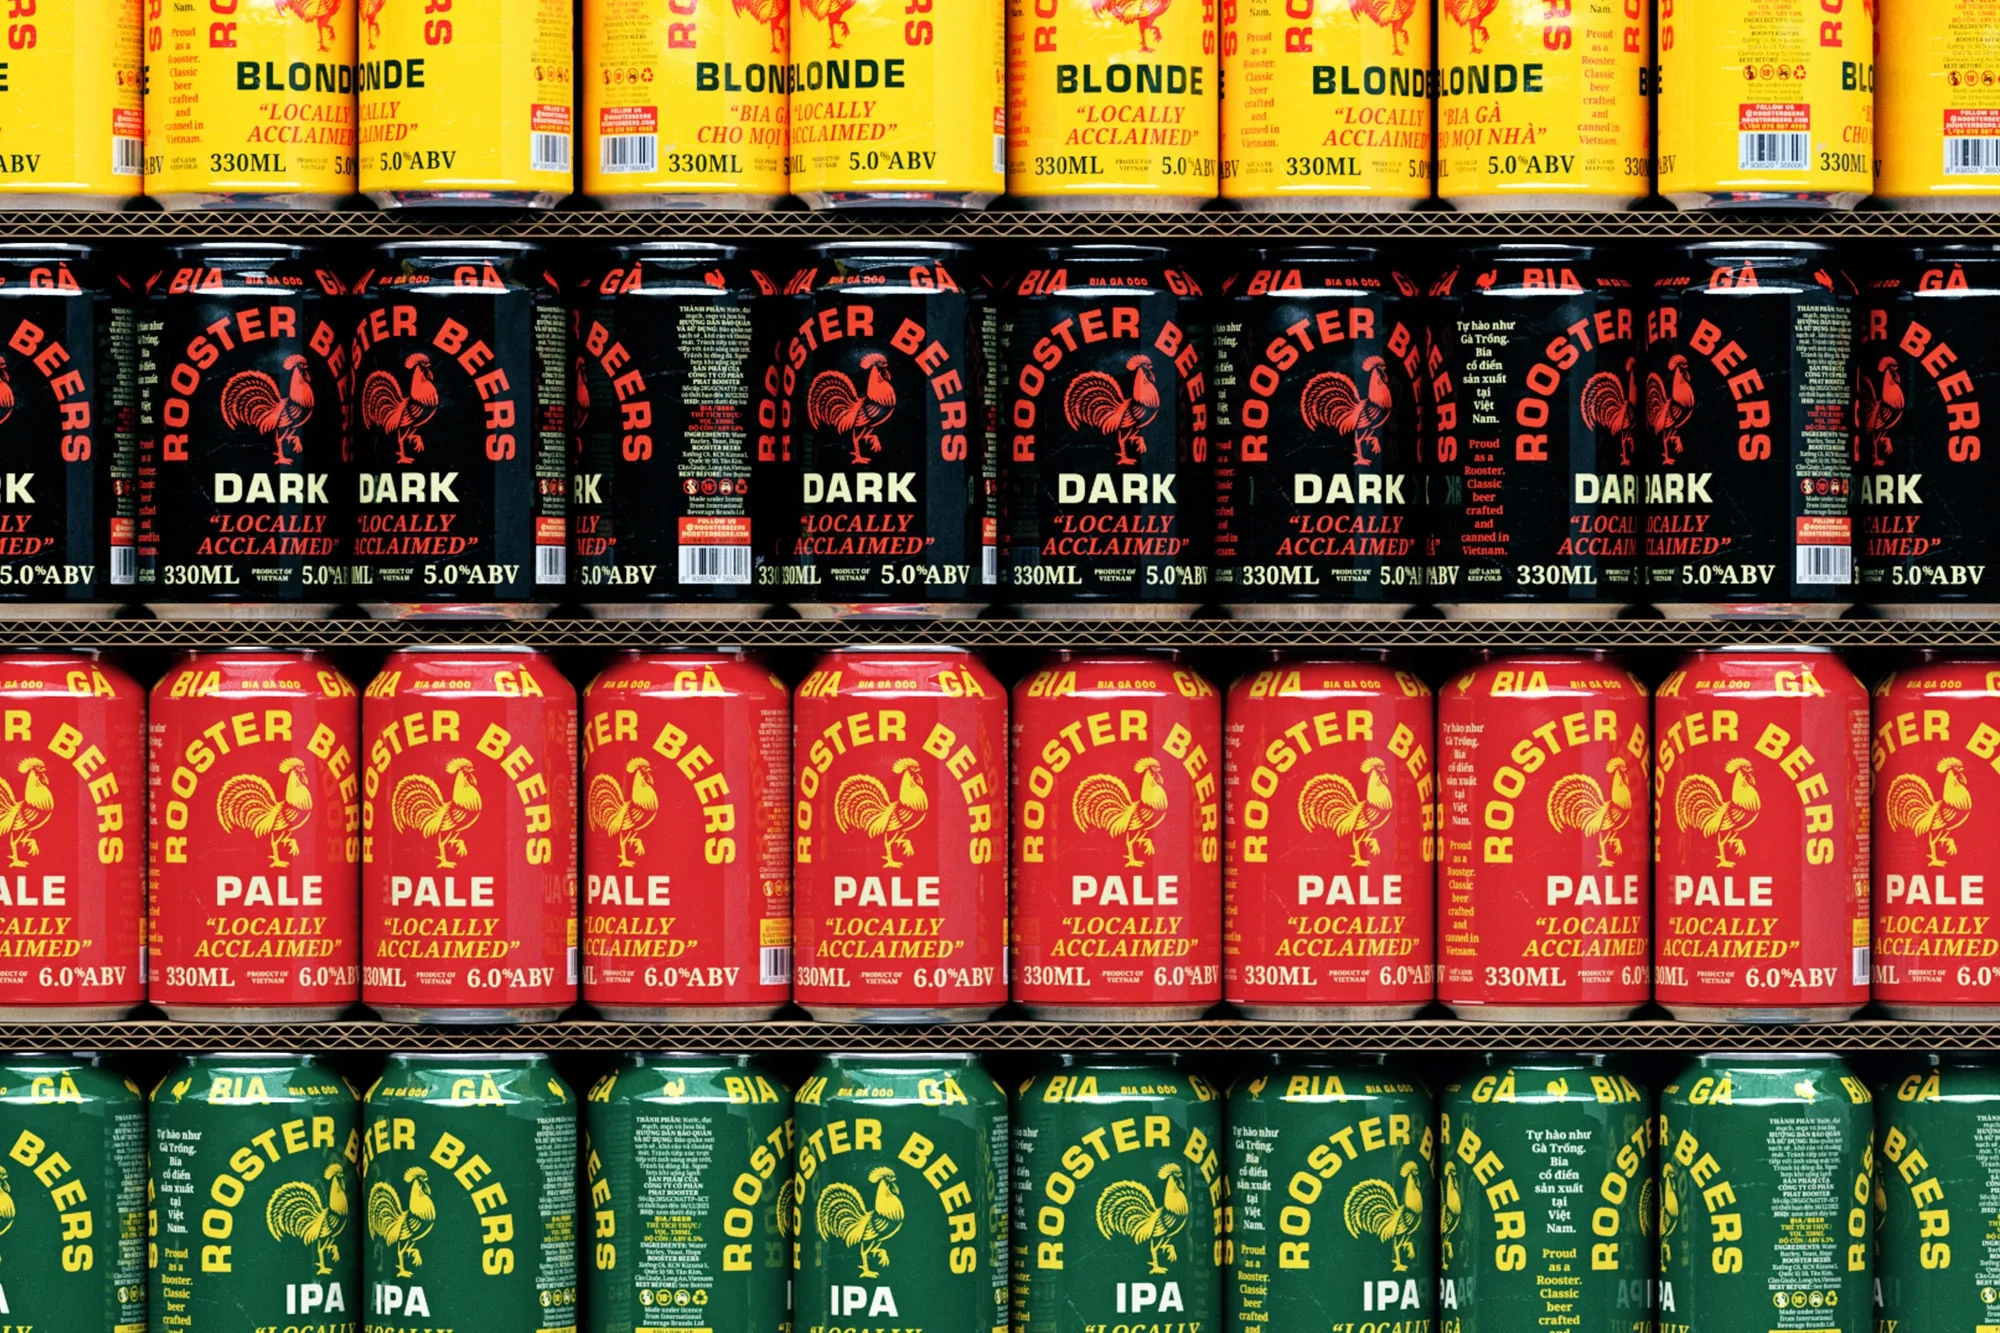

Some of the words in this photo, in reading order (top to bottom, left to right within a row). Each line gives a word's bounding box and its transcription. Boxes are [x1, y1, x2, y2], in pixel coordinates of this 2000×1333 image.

[1587, 29, 1613, 39] Proud
[1057, 64, 1203, 95] BLONDE
[1077, 105, 1186, 127] “LOCALLY
[1592, 109, 1608, 118] and
[698, 126, 743, 143] CHO
[1066, 128, 1199, 145] ACCLAIMED”
[1488, 123, 1546, 144] NHÀ”
[211, 154, 286, 172] 330ML
[381, 151, 456, 171] 5.0%ABV
[669, 154, 742, 173] 330ML
[850, 151, 936, 170] 5.0%ABV
[1035, 156, 1103, 175] 330ML
[1287, 157, 1361, 175] 330ML
[1489, 156, 1574, 174] 5.0%ABV
[1821, 152, 1867, 173] 330ML
[1472, 321, 1492, 332] hào
[1495, 320, 1515, 330] như
[1461, 334, 1473, 344] Gà
[1476, 347, 1492, 357] Bia
[9, 319, 91, 462] BEERS
[164, 306, 296, 461] ROOSTER
[432, 317, 515, 461] BEERS
[1013, 306, 1139, 461] ROOSTER
[1477, 387, 1490, 398] tại
[1689, 318, 1770, 461] BEERS
[1474, 400, 1494, 411] Việt
[1473, 414, 1499, 423] Nam.
[1470, 439, 1500, 448] Proud
[1465, 466, 1505, 475] Rooster.
[215, 473, 328, 503] DARK
[360, 472, 459, 503] DARK
[804, 472, 916, 503] DARK
[1059, 473, 1176, 503] DARK
[1295, 474, 1405, 504] DARK
[1467, 479, 1502, 488] Classic
[1473, 492, 1496, 502] beer
[1466, 505, 1503, 515] crafted
[210, 515, 326, 532] “LOCALLY
[801, 514, 913, 533] “LOCALLY
[1054, 515, 1174, 533] “LOCALLY
[1290, 515, 1403, 533] “LOCALLY
[1475, 519, 1493, 528] and
[197, 537, 338, 555] ACCLAIMED”
[1042, 538, 1189, 555] ACCLAIMED”
[1276, 538, 1414, 555] ACCLAIMED”
[1461, 532, 1495, 542] canned
[1498, 532, 1509, 542] in
[1463, 546, 1507, 555] Vietnam.
[0, 565, 94, 584] 5.0%ABV
[165, 565, 239, 584] 330ML
[424, 565, 519, 584] 5.0%ABV
[582, 565, 656, 584] 5.0%ABV
[882, 565, 970, 584] 5.0%ABV
[1014, 566, 1082, 584] 330ML
[1243, 566, 1319, 585] 330ML
[1517, 565, 1597, 584] 330ML
[1683, 565, 1775, 584] 5.0%ABV
[1893, 566, 1985, 585] 5.0%ABV
[170, 671, 220, 697] BIA
[800, 671, 842, 697] BIA
[1028, 671, 1076, 697] BIA
[1249, 671, 1301, 697] BIA
[1490, 671, 1549, 696] BIA
[1774, 665, 1825, 696] GÀ
[48, 722, 124, 863] BEERS
[166, 710, 292, 863] ROOSTER
[476, 723, 551, 864] BEERS
[922, 723, 992, 864] BEERS
[1024, 710, 1147, 863] ROOSTER
[1163, 722, 1217, 863] BEERS
[1244, 710, 1373, 863] ROOSTER
[1485, 710, 1616, 863] ROOSTER
[1754, 723, 1834, 864] BEERS
[217, 876, 322, 906] PALE
[392, 876, 494, 906] PALE
[589, 875, 670, 905] PALE
[835, 876, 940, 906] PALE
[1073, 875, 1178, 905] PALE
[1299, 875, 1401, 905] PALE
[1548, 875, 1637, 905] PALE
[1675, 876, 1772, 906] PALE
[1887, 875, 1984, 905] PALE
[207, 917, 326, 935] “LOCALLY
[385, 918, 499, 936] “LOCALLY
[826, 918, 945, 936] “LOCALLY
[1288, 916, 1405, 934] “LOCALLY
[1670, 917, 1778, 936] “LOCALLY
[1883, 916, 1989, 934] “LOCALLY
[194, 939, 341, 957] ACCLAIMED”
[377, 940, 520, 958] ACCLAIMED”
[817, 940, 964, 958] ACCLAIMED”
[1051, 939, 1198, 957] ACCLAIMED”
[1275, 938, 1419, 956] ACCLAIMED”
[39, 967, 126, 986] 6.0%ABV
[167, 967, 235, 986] 330ML
[467, 968, 554, 987] 6.0%ABV
[645, 967, 740, 986] 6.0%ABV
[798, 967, 850, 987] 330ML
[914, 967, 993, 987] 6.0%ABV
[1024, 966, 1090, 986] 330ML
[1246, 966, 1317, 985] 330ML
[1486, 967, 1566, 986] 330ML
[1746, 968, 1837, 987] 6.0%ABV
[1526, 1130, 1543, 1141] Tự
[1546, 1130, 1566, 1139] hào
[1569, 1130, 1591, 1139] như
[1532, 1143, 1547, 1153] Gà
[1549, 1143, 1586, 1155] Trống.
[1551, 1157, 1568, 1166] Bia
[9, 1130, 94, 1272] BEERS
[202, 1116, 335, 1272] ROOSTER
[1037, 1116, 1170, 1270] ROOSTER
[1279, 1114, 1410, 1269] ROOSTER
[1457, 1128, 1526, 1271] BEERS
[1883, 1126, 1950, 1268] BEERS
[898, 1132, 977, 1275] BEERS
[1552, 1197, 1567, 1207] tại
[1548, 1210, 1570, 1221] Việt
[1547, 1224, 1576, 1233] Nam.
[1543, 1249, 1576, 1258] Proud
[1537, 1276, 1582, 1285] Rooster.
[287, 1283, 344, 1314] IPA
[376, 1284, 430, 1317] IPA
[831, 1285, 898, 1317] IPA
[1117, 1282, 1183, 1313] IPA
[1364, 1279, 1419, 1311] IPA
[1540, 1288, 1578, 1298] Classic
[1547, 1302, 1572, 1312] beer
[1539, 1315, 1580, 1325] crafted
